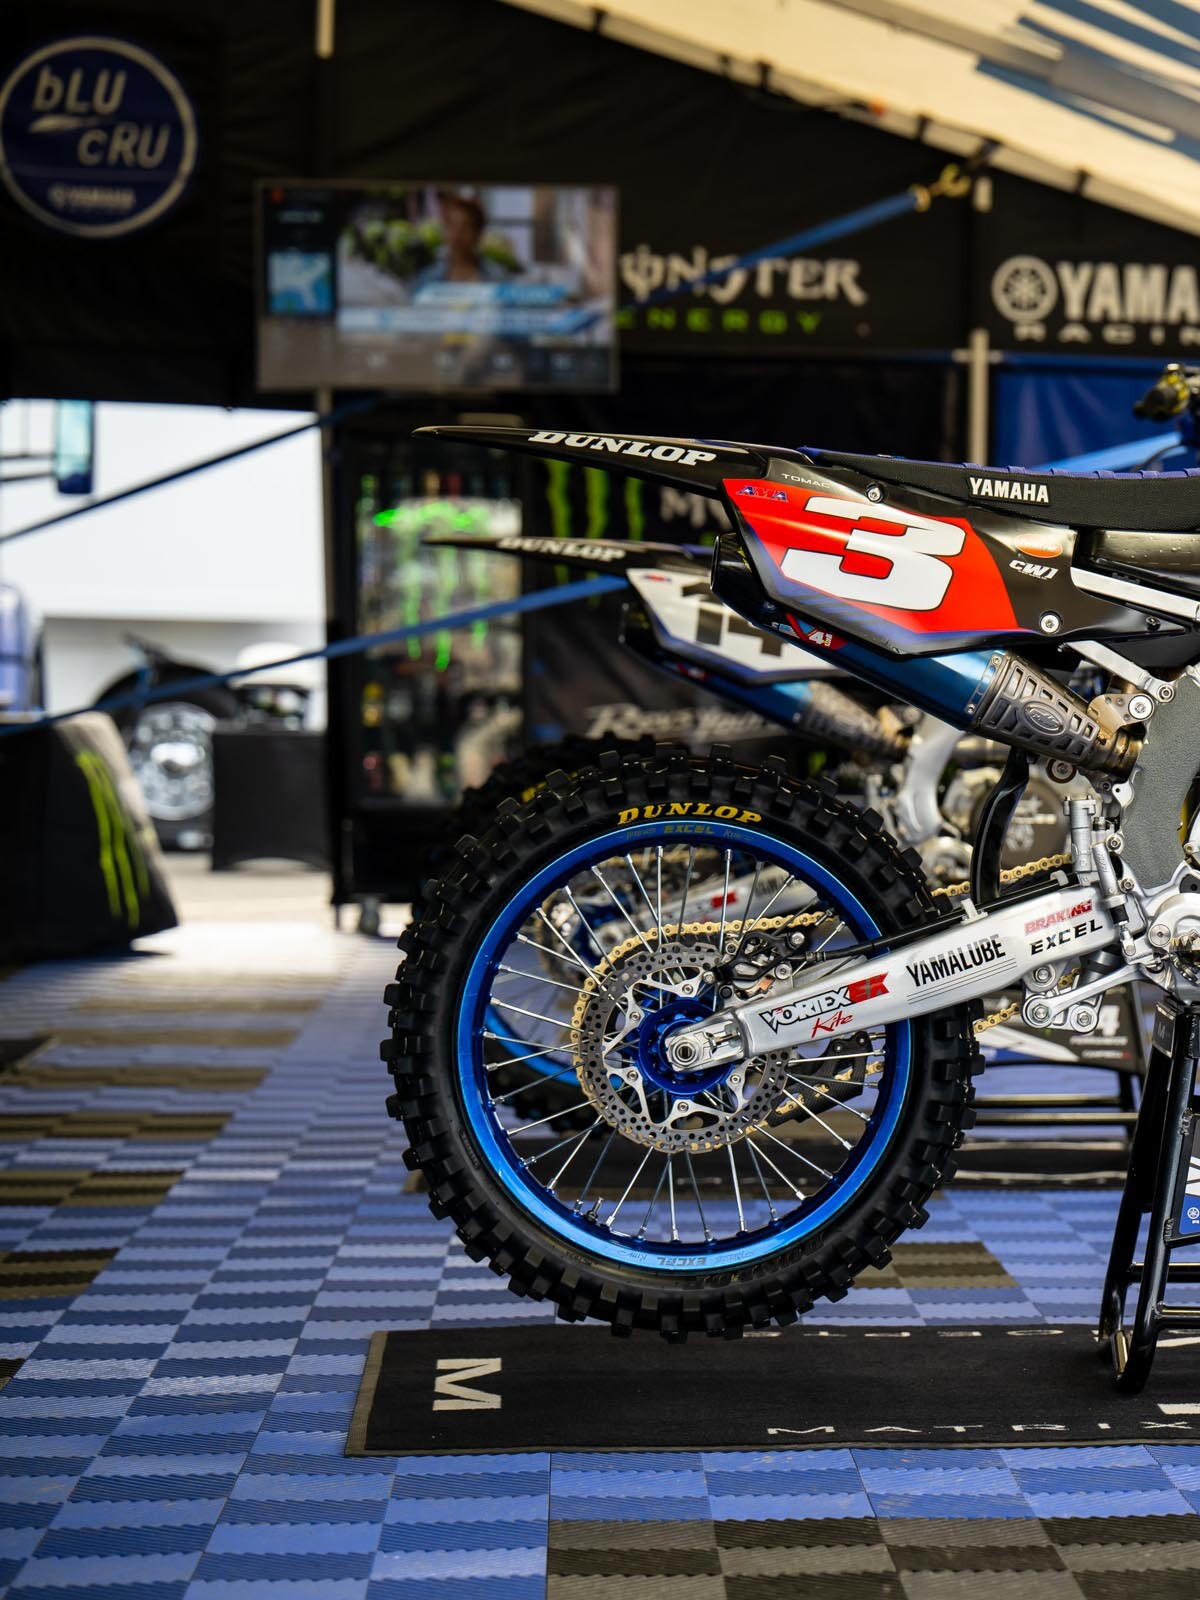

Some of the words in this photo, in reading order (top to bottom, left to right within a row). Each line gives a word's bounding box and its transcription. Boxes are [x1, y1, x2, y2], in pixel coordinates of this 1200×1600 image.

[619, 245, 869, 307] ONSTER
[527, 431, 717, 466] DUNLOP
[782, 473, 831, 488] TOMAC
[968, 477, 1050, 504] YAMAHA
[497, 536, 627, 563] DUNLOP
[780, 496, 967, 612] 3
[617, 801, 763, 826] DUNLOP
[1023, 899, 1093, 936] BRAKING
[1029, 918, 1104, 956] EXCEL
[905, 934, 1006, 988] YAMALUBE
[767, 1419, 1193, 1435] MATRIX
